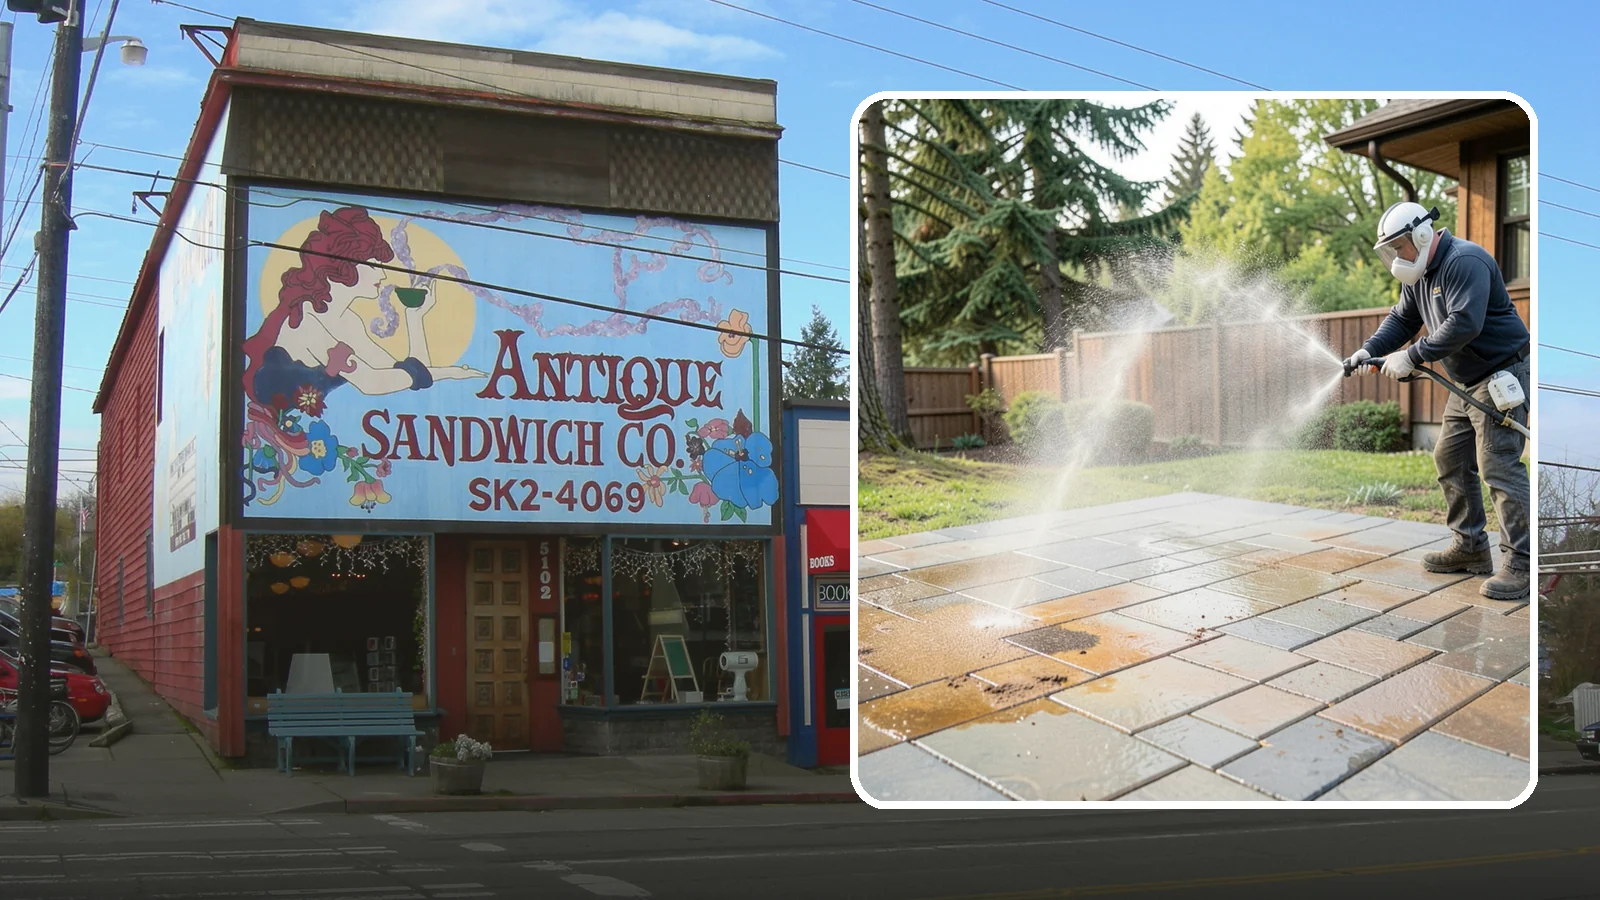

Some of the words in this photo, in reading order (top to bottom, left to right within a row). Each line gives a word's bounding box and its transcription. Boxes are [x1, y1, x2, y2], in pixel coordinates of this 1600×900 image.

[476, 330, 723, 420] ANTIQUE
[362, 409, 604, 467] SANDWICH
[617, 421, 685, 469] CO.
[469, 478, 645, 512] SK2-4069
[540, 541, 551, 600] 5102
[809, 555, 835, 569] BOOKS
